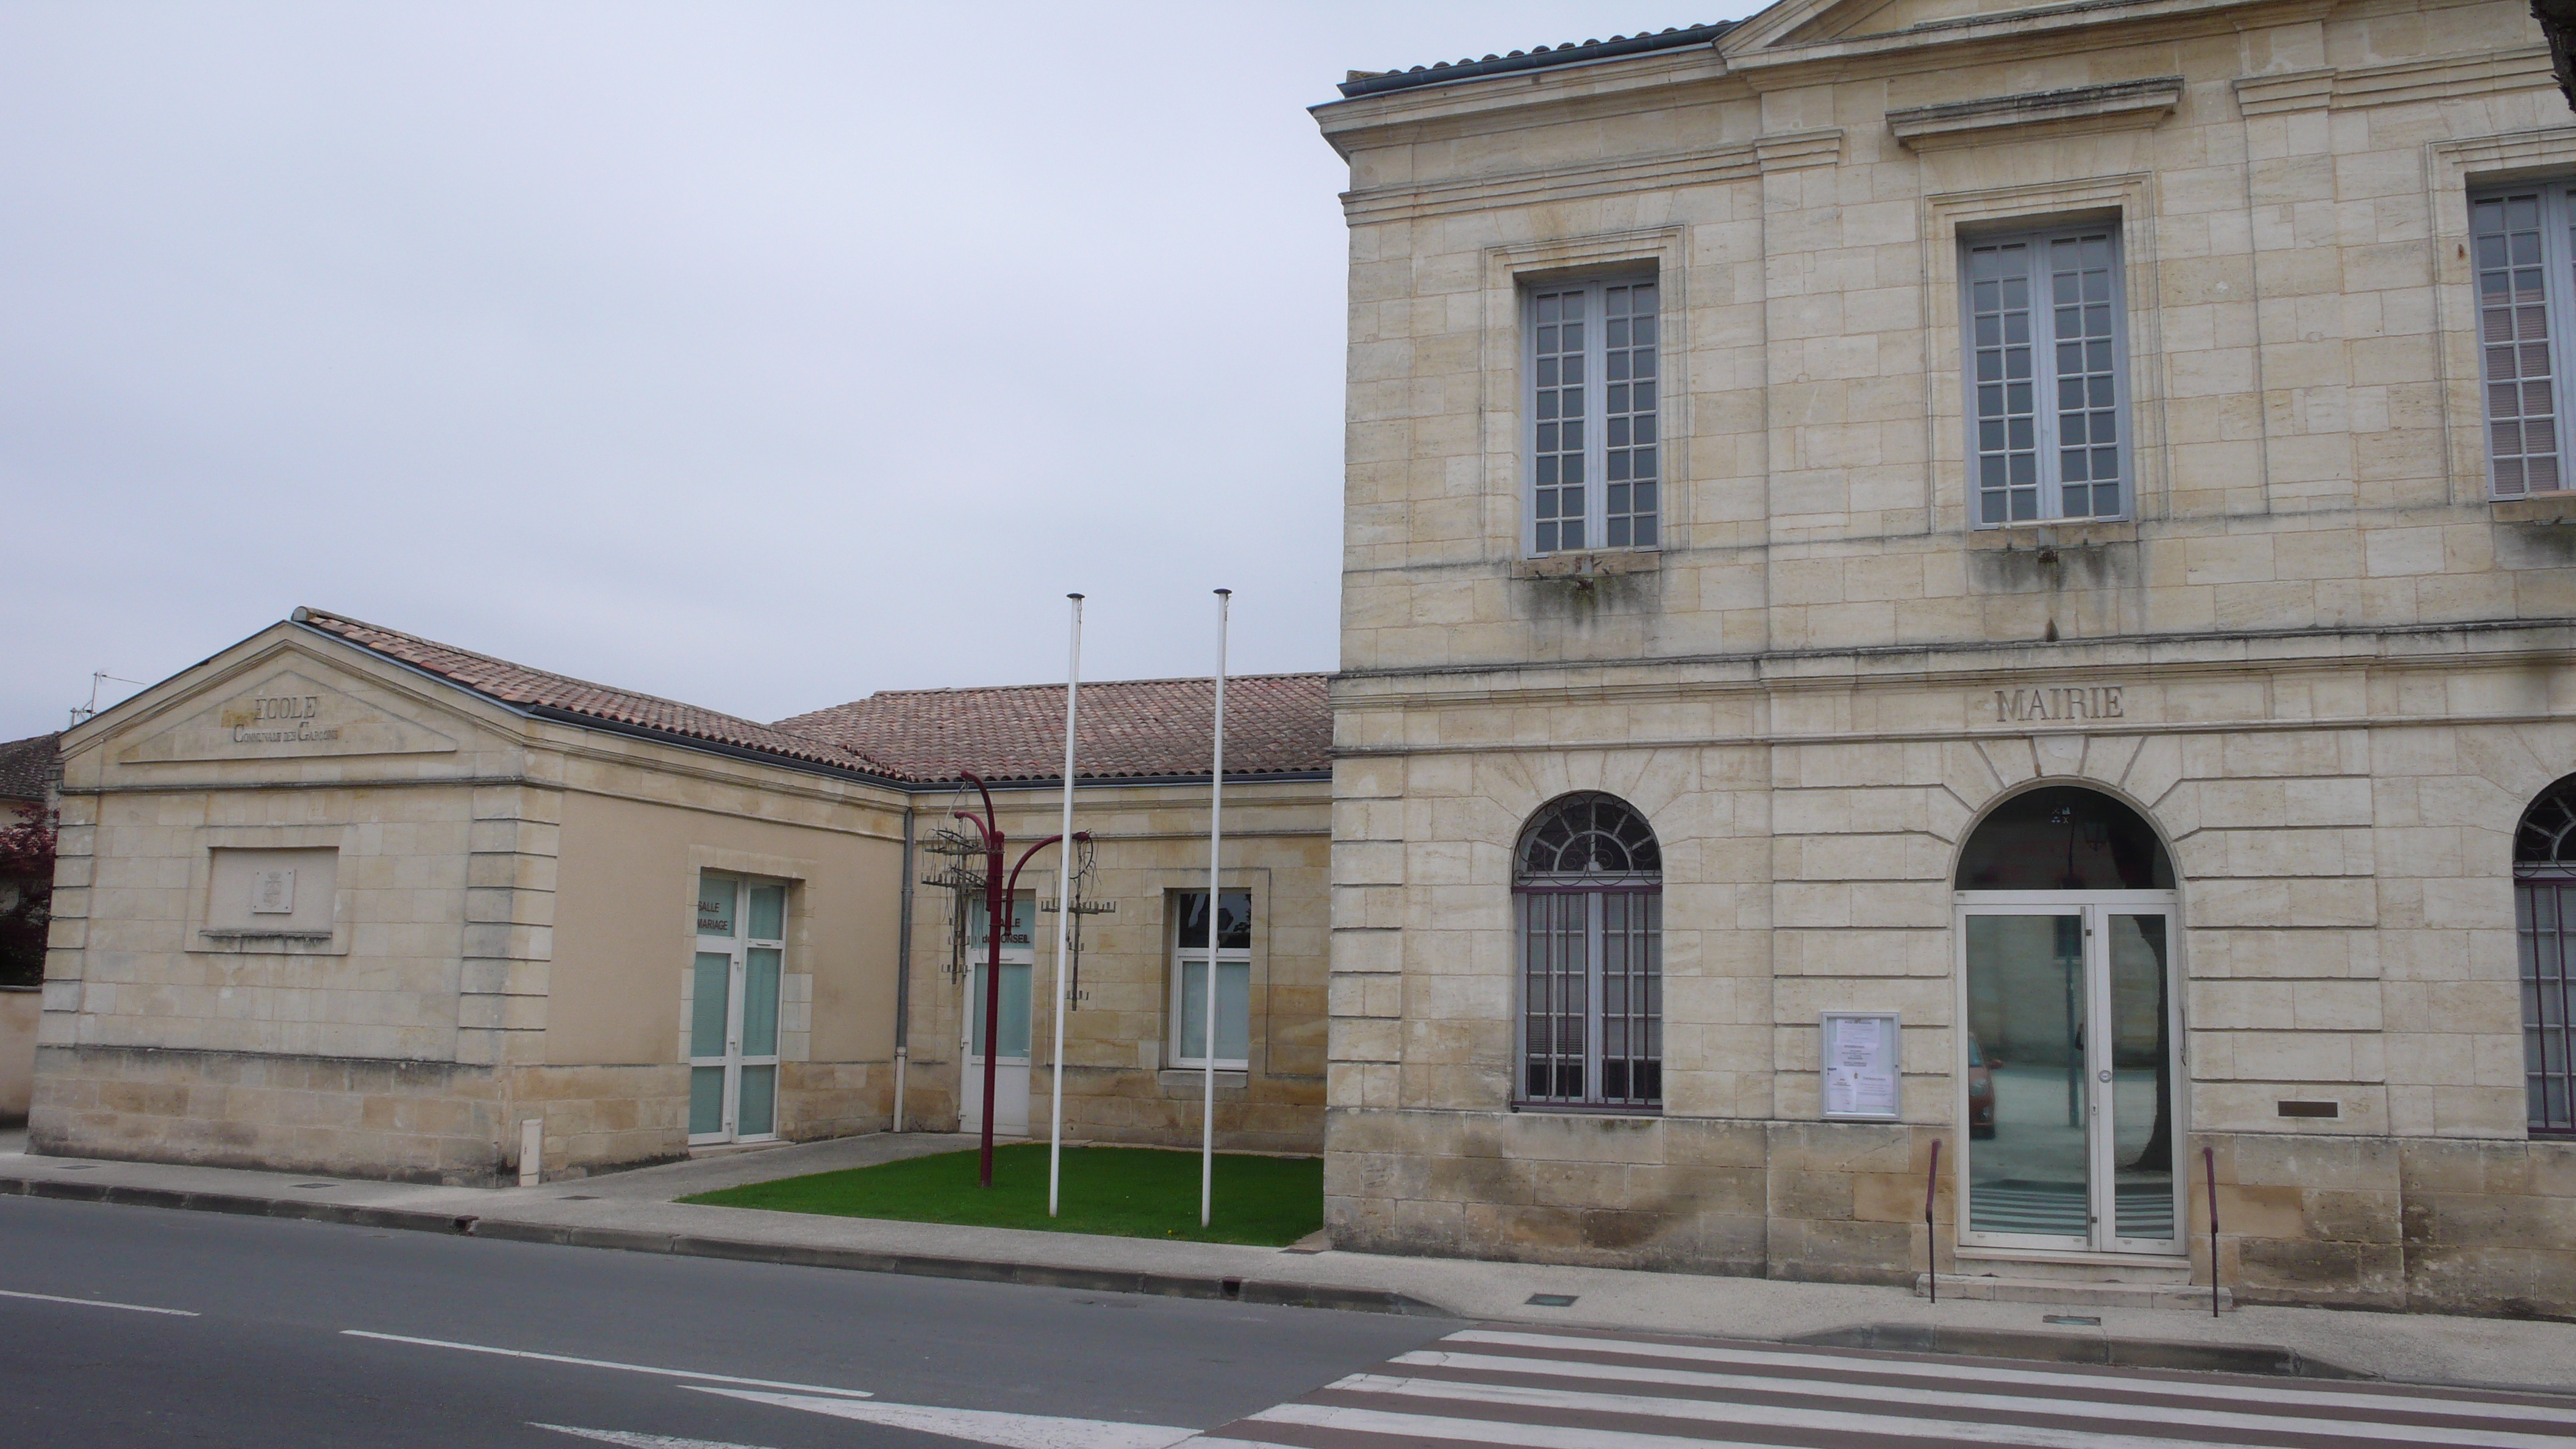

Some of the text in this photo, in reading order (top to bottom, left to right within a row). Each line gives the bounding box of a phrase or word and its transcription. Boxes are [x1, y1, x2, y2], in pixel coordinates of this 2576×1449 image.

[254, 696, 317, 720] ECOLE
[1994, 685, 2123, 722] MAIRIE
[698, 901, 720, 913] SALLE
[1000, 934, 1030, 944] ONSEIL
